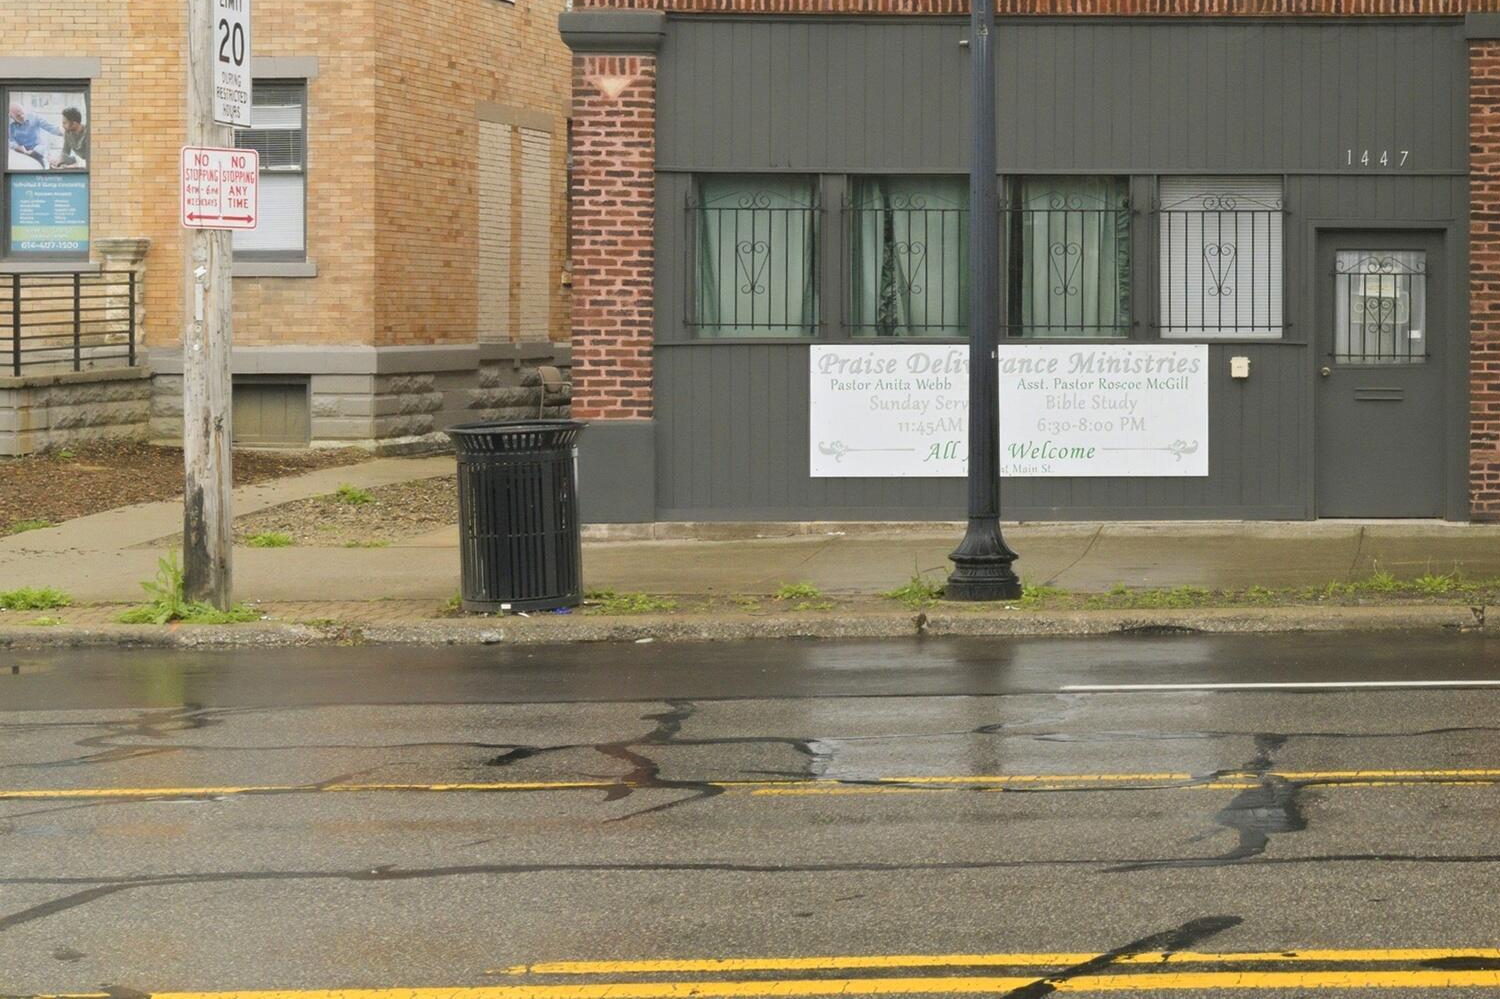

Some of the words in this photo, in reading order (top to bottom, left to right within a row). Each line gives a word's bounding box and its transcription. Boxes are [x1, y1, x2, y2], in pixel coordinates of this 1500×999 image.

[219, 18, 245, 67] 20
[222, 71, 242, 89] DURING
[216, 85, 248, 105] RESTRICTED
[222, 102, 241, 119] HOURS
[194, 154, 210, 167] NO
[231, 156, 246, 168] NO
[1345, 148, 1410, 167] 1447
[185, 169, 219, 183] STOPPING
[222, 170, 255, 184] STOPPING
[228, 185, 248, 197] ANY
[227, 197, 249, 209] TIME
[818, 351, 897, 375] Praise
[1068, 351, 1201, 375] Ministries
[830, 378, 871, 391] Pastor
[874, 378, 912, 391] Anita
[915, 377, 952, 391] Webb
[1016, 377, 1048, 390] Asst.
[1054, 377, 1094, 390] Pastor
[1098, 378, 1142, 391] Roscoe
[1146, 376, 1189, 390] McGill
[869, 395, 930, 416] Sunday
[935, 395, 968, 411] Serv
[1045, 394, 1086, 410] Bible
[1091, 395, 1139, 414] Study
[897, 417, 963, 436] 11:45AM
[1036, 417, 1114, 435] 6:30-8:00
[1119, 417, 1147, 432] PM
[923, 440, 961, 462] All
[1007, 440, 1096, 460] Welcome
[1012, 463, 1038, 473] Main
